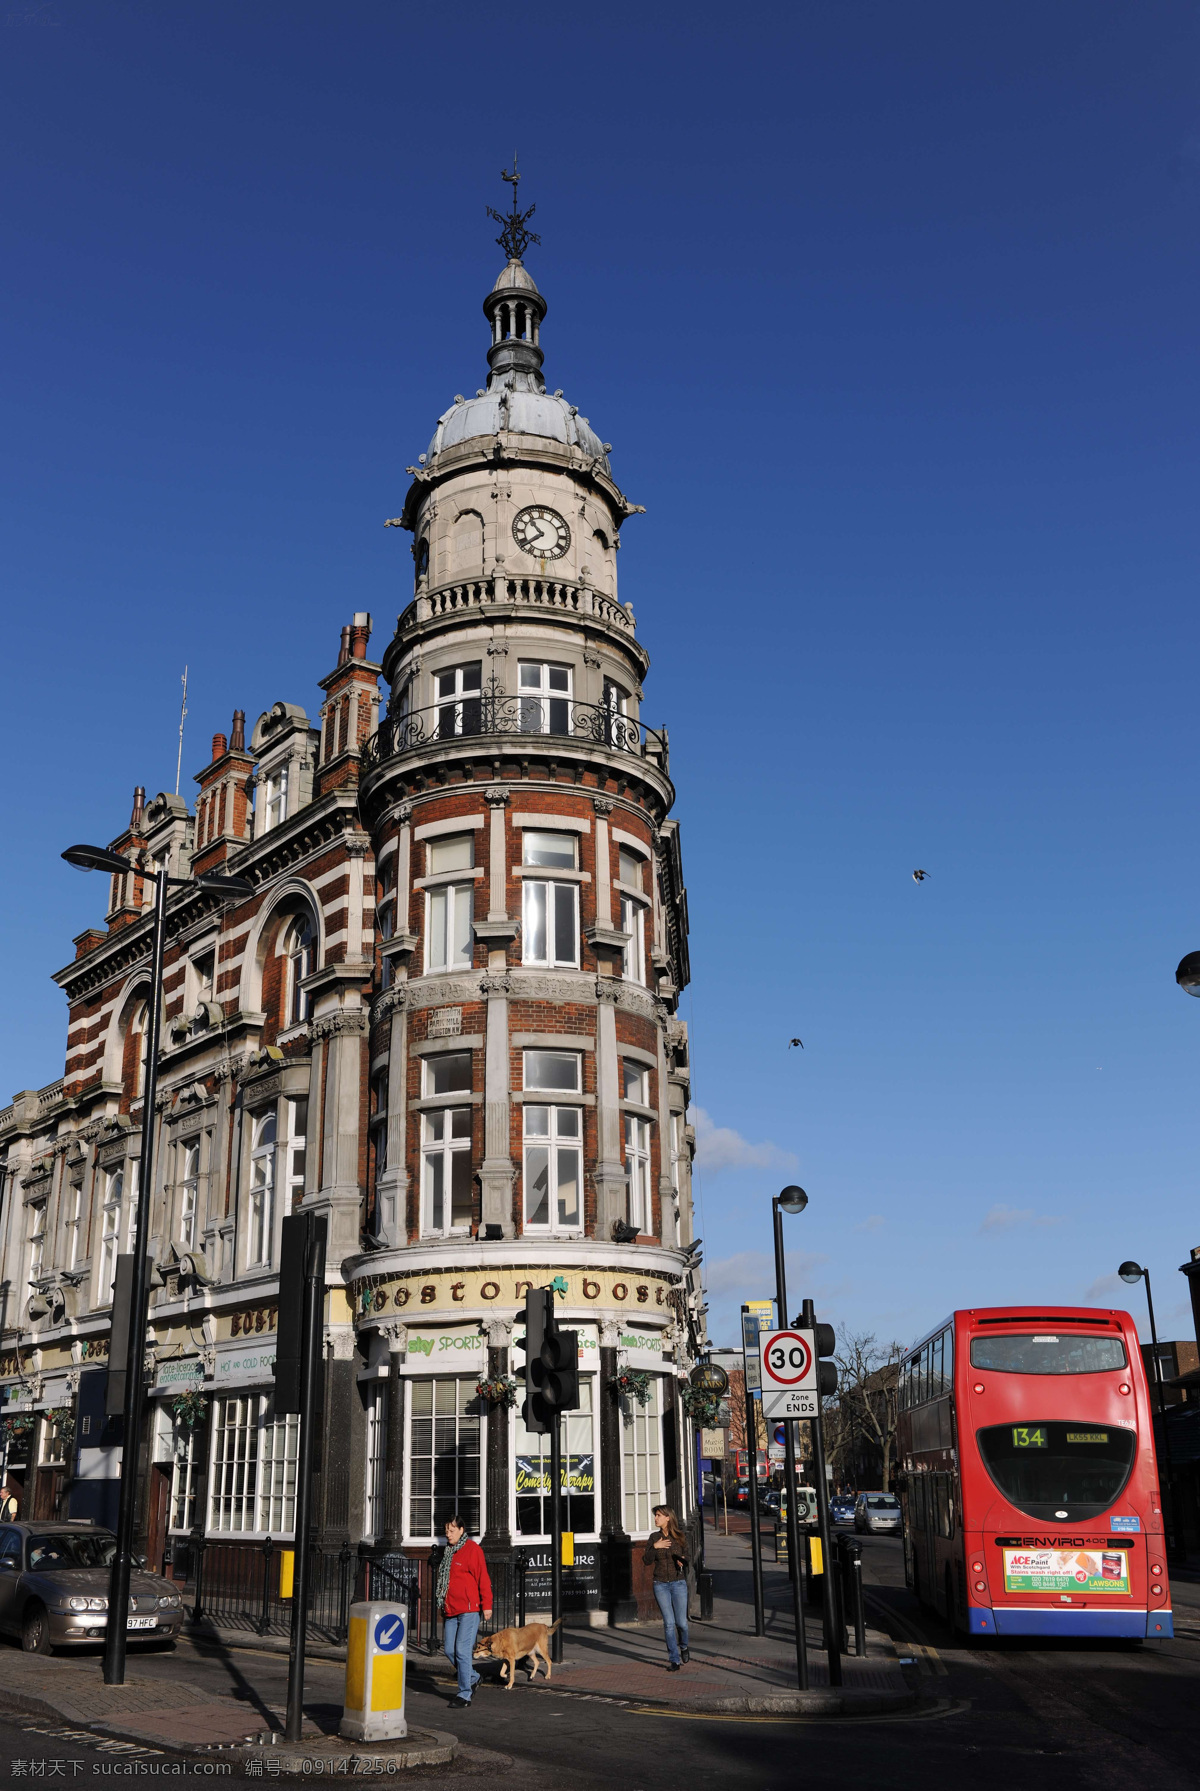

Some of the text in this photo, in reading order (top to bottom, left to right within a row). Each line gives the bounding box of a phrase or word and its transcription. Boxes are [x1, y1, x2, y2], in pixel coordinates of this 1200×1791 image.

[408, 1335, 484, 1357] sky SPORTS
[637, 1336, 661, 1351] SPORTS
[220, 1360, 232, 1372] HOT
[242, 1357, 258, 1369] COLD
[771, 1347, 805, 1369] 30
[786, 1403, 815, 1412] ENDS
[1013, 1428, 1045, 1447] 134
[704, 1446, 724, 1454] ROOM
[516, 1469, 552, 1493] Comedy
[1023, 1537, 1085, 1547] ENVIRO
[528, 1554, 552, 1567] alls
[1010, 1555, 1031, 1565] ACE
[127, 1618, 154, 1627] 97 HFC
